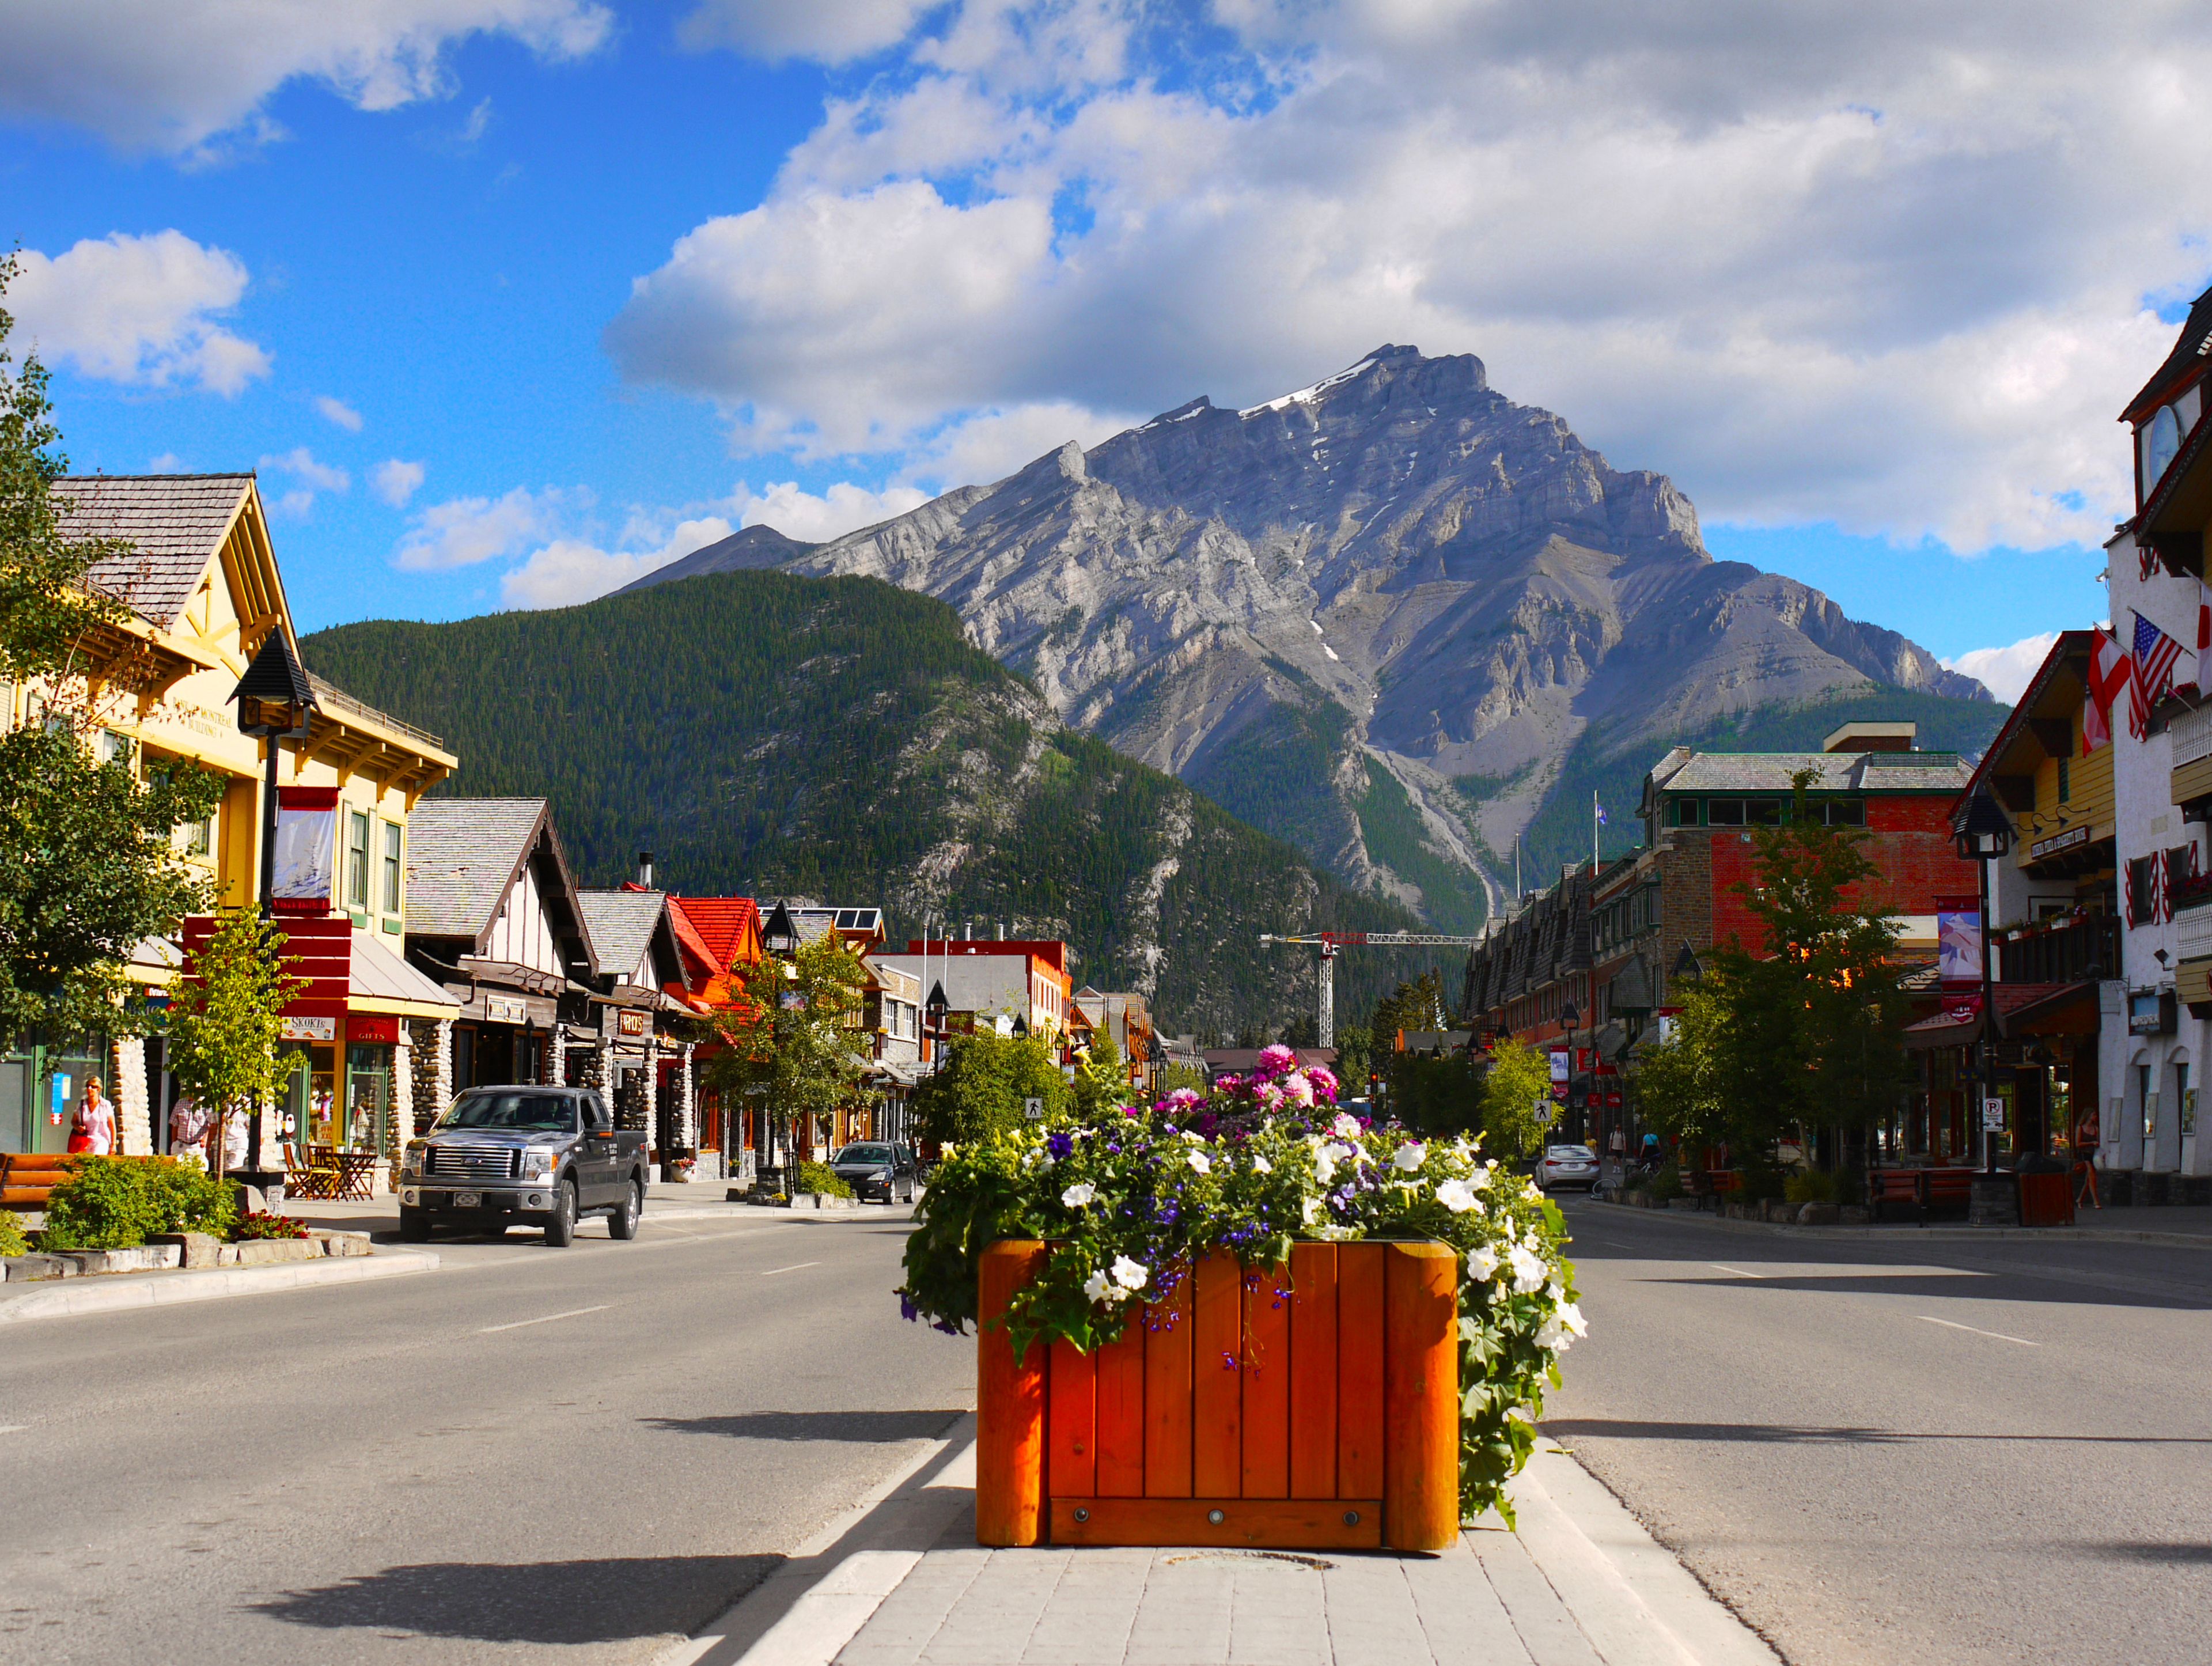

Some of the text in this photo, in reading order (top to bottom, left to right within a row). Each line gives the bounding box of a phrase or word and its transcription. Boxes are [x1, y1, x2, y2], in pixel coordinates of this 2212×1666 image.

[173, 696, 189, 712] BNK
[201, 707, 232, 729] MONTREAL
[188, 718, 217, 738] BUILDING
